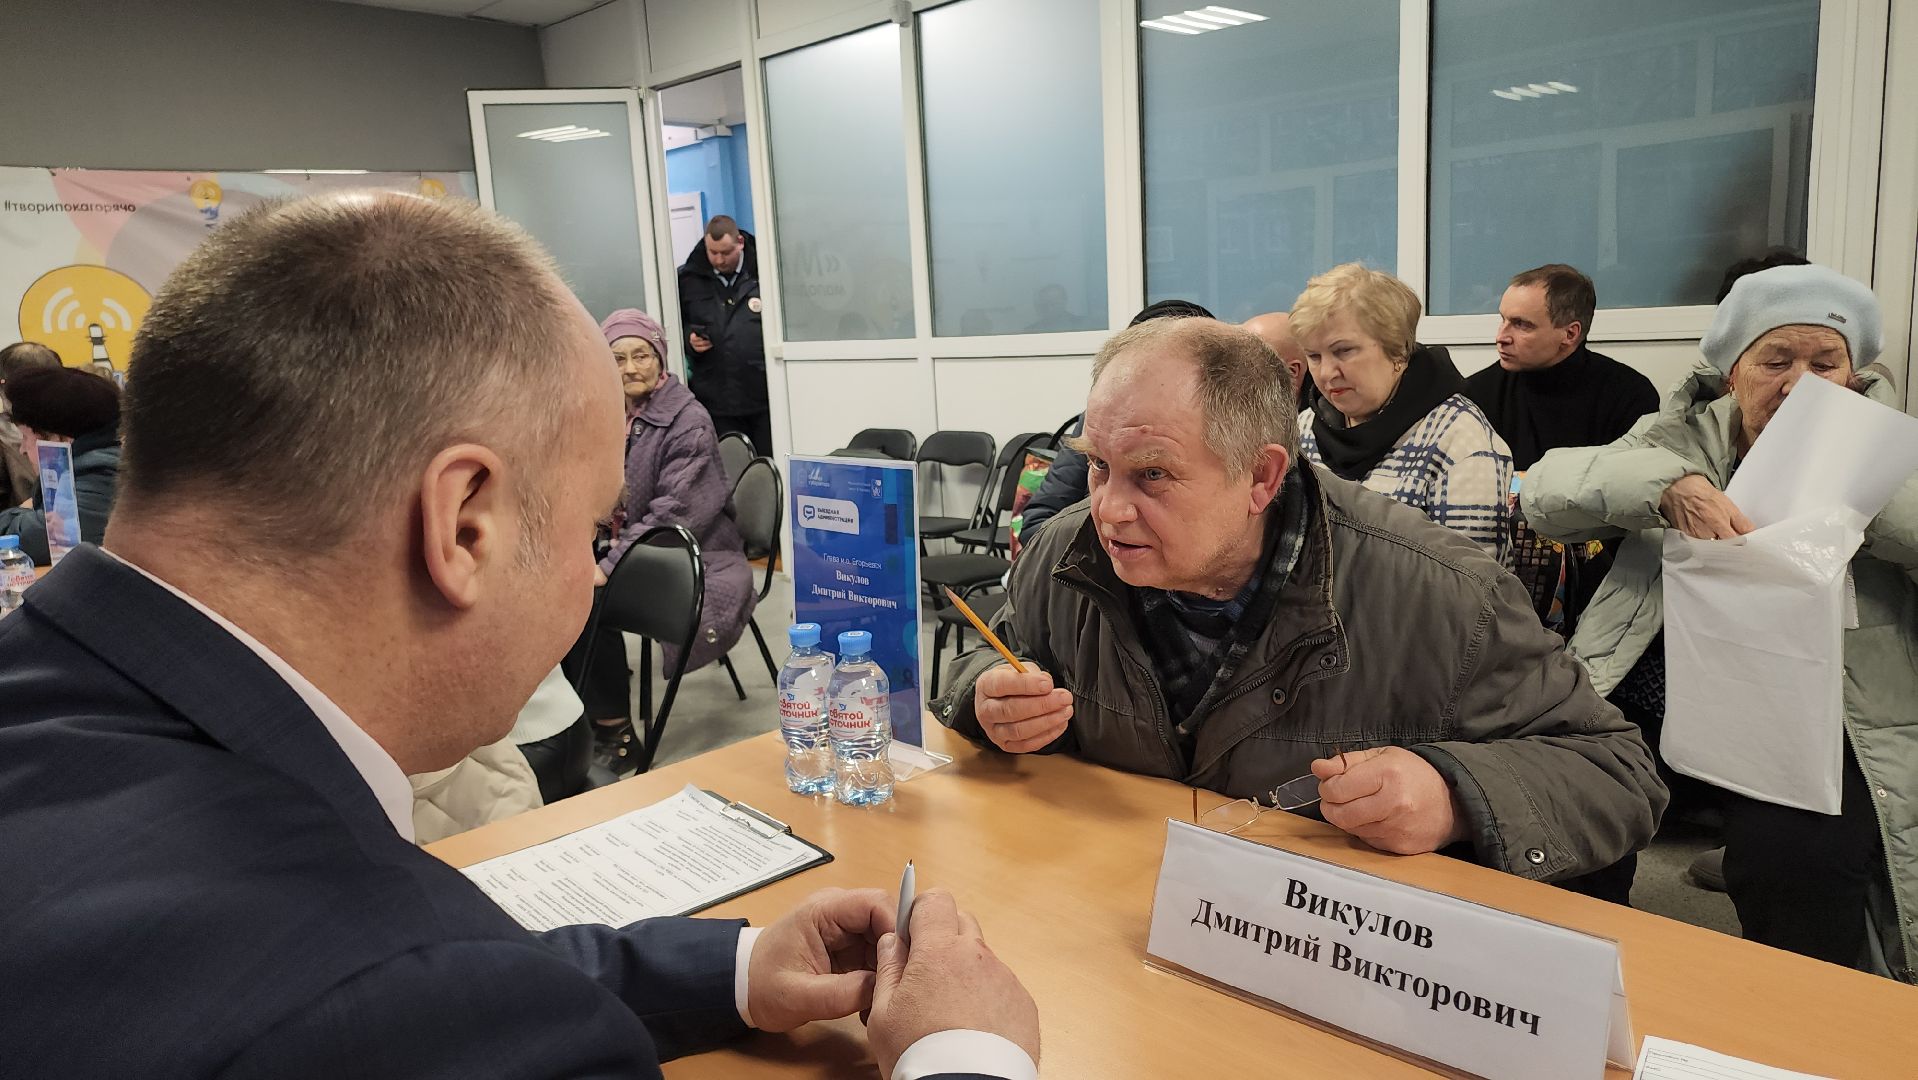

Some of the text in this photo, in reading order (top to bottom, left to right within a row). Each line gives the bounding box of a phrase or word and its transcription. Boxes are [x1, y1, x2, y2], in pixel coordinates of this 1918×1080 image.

[4, 200, 137, 214] #творипокагорячо
[823, 553, 840, 563] Глава
[836, 570, 870, 586] Викулов
[812, 584, 897, 609] Дмитрий Викторович
[1282, 877, 1434, 949] Викулов
[1191, 897, 1542, 1036] Дмитрий Викторович
